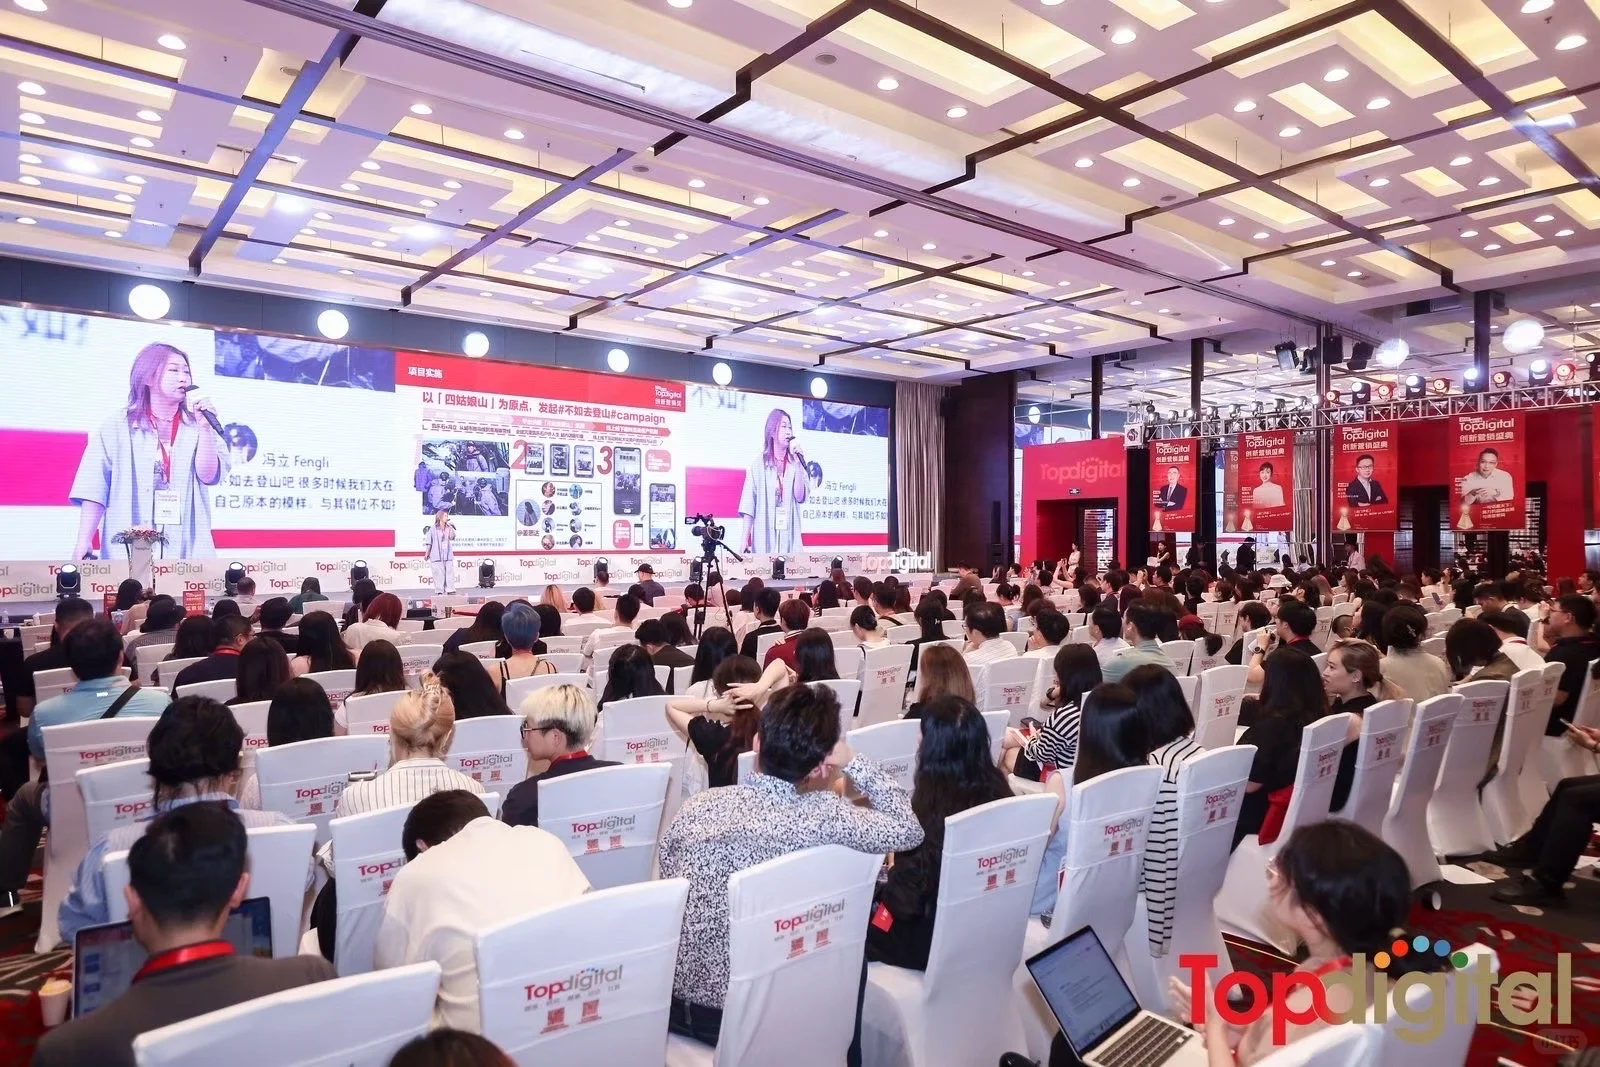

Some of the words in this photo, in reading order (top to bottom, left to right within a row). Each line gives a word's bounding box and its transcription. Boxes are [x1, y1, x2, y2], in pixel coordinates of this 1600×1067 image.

[408, 366, 443, 379] 项目实施
[1459, 418, 1515, 432] Topdigital
[1342, 428, 1389, 442] Topdigital
[1459, 431, 1514, 443] 创新营销盛典
[1246, 436, 1286, 449] Topdigital
[1156, 444, 1190, 456] Topdigital
[262, 452, 289, 468] 冯立
[294, 455, 329, 471] Fengli
[597, 446, 612, 474] 3
[1040, 457, 1125, 484] Topdigital
[839, 482, 857, 493] Fengli
[242, 561, 287, 574] opdigital
[520, 557, 556, 568] Topdigital
[860, 549, 931, 574] Topdigital
[152, 562, 203, 576] opdigital
[544, 571, 580, 581] Topdigital
[0, 583, 53, 597] opdigital
[626, 738, 669, 750] Topdigital
[79, 744, 146, 760] Topdigital
[460, 754, 513, 768] Topdigital
[572, 815, 635, 833] Topdigital
[977, 846, 1029, 868] Topdigital
[774, 898, 845, 932] Topdigital
[524, 964, 623, 1001] Topdigital
